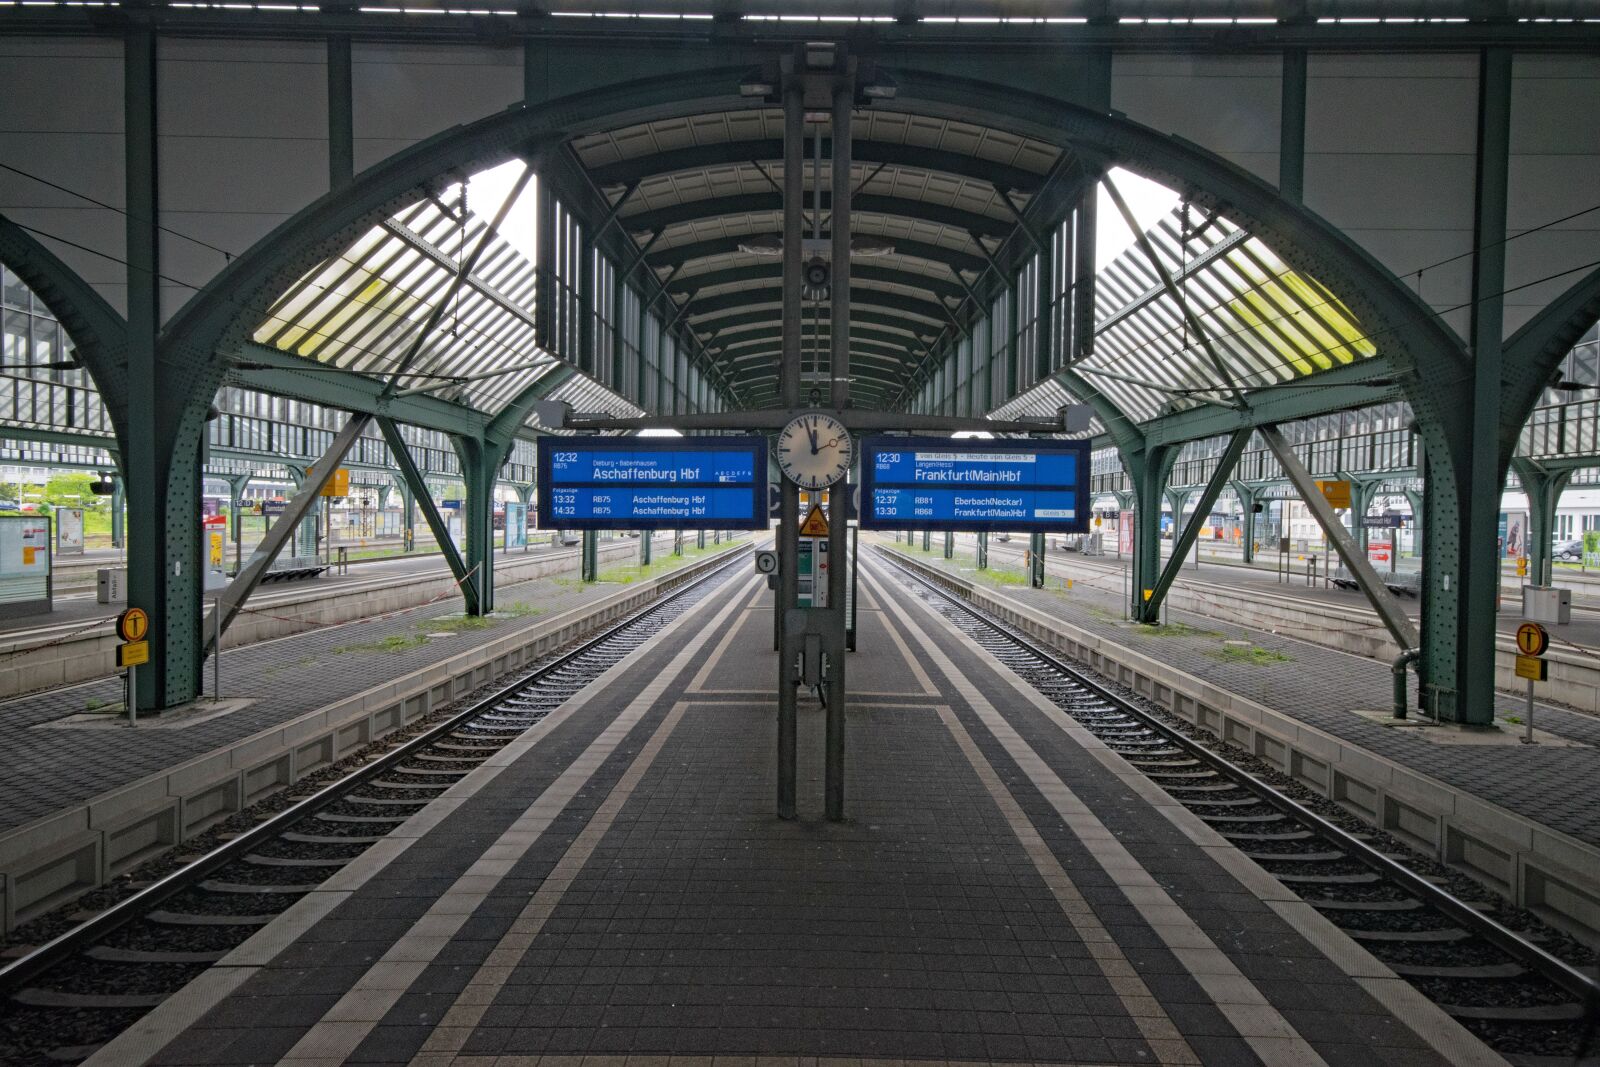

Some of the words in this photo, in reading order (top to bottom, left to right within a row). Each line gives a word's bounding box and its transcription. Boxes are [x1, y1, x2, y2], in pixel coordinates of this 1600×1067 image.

[554, 452, 578, 462] 12:32
[876, 453, 900, 462] 12:30
[593, 468, 677, 482] Aschaffenburg
[680, 468, 700, 479] Hbf
[915, 469, 1021, 482] Frankfurt(Main)Hbf
[633, 496, 690, 505] Aschaffenburg
[954, 497, 1022, 506] Eberbach(Neckar)
[633, 507, 690, 516] Aschaffenburg
[954, 508, 1026, 517] Frankfurt(Main)Hbf
